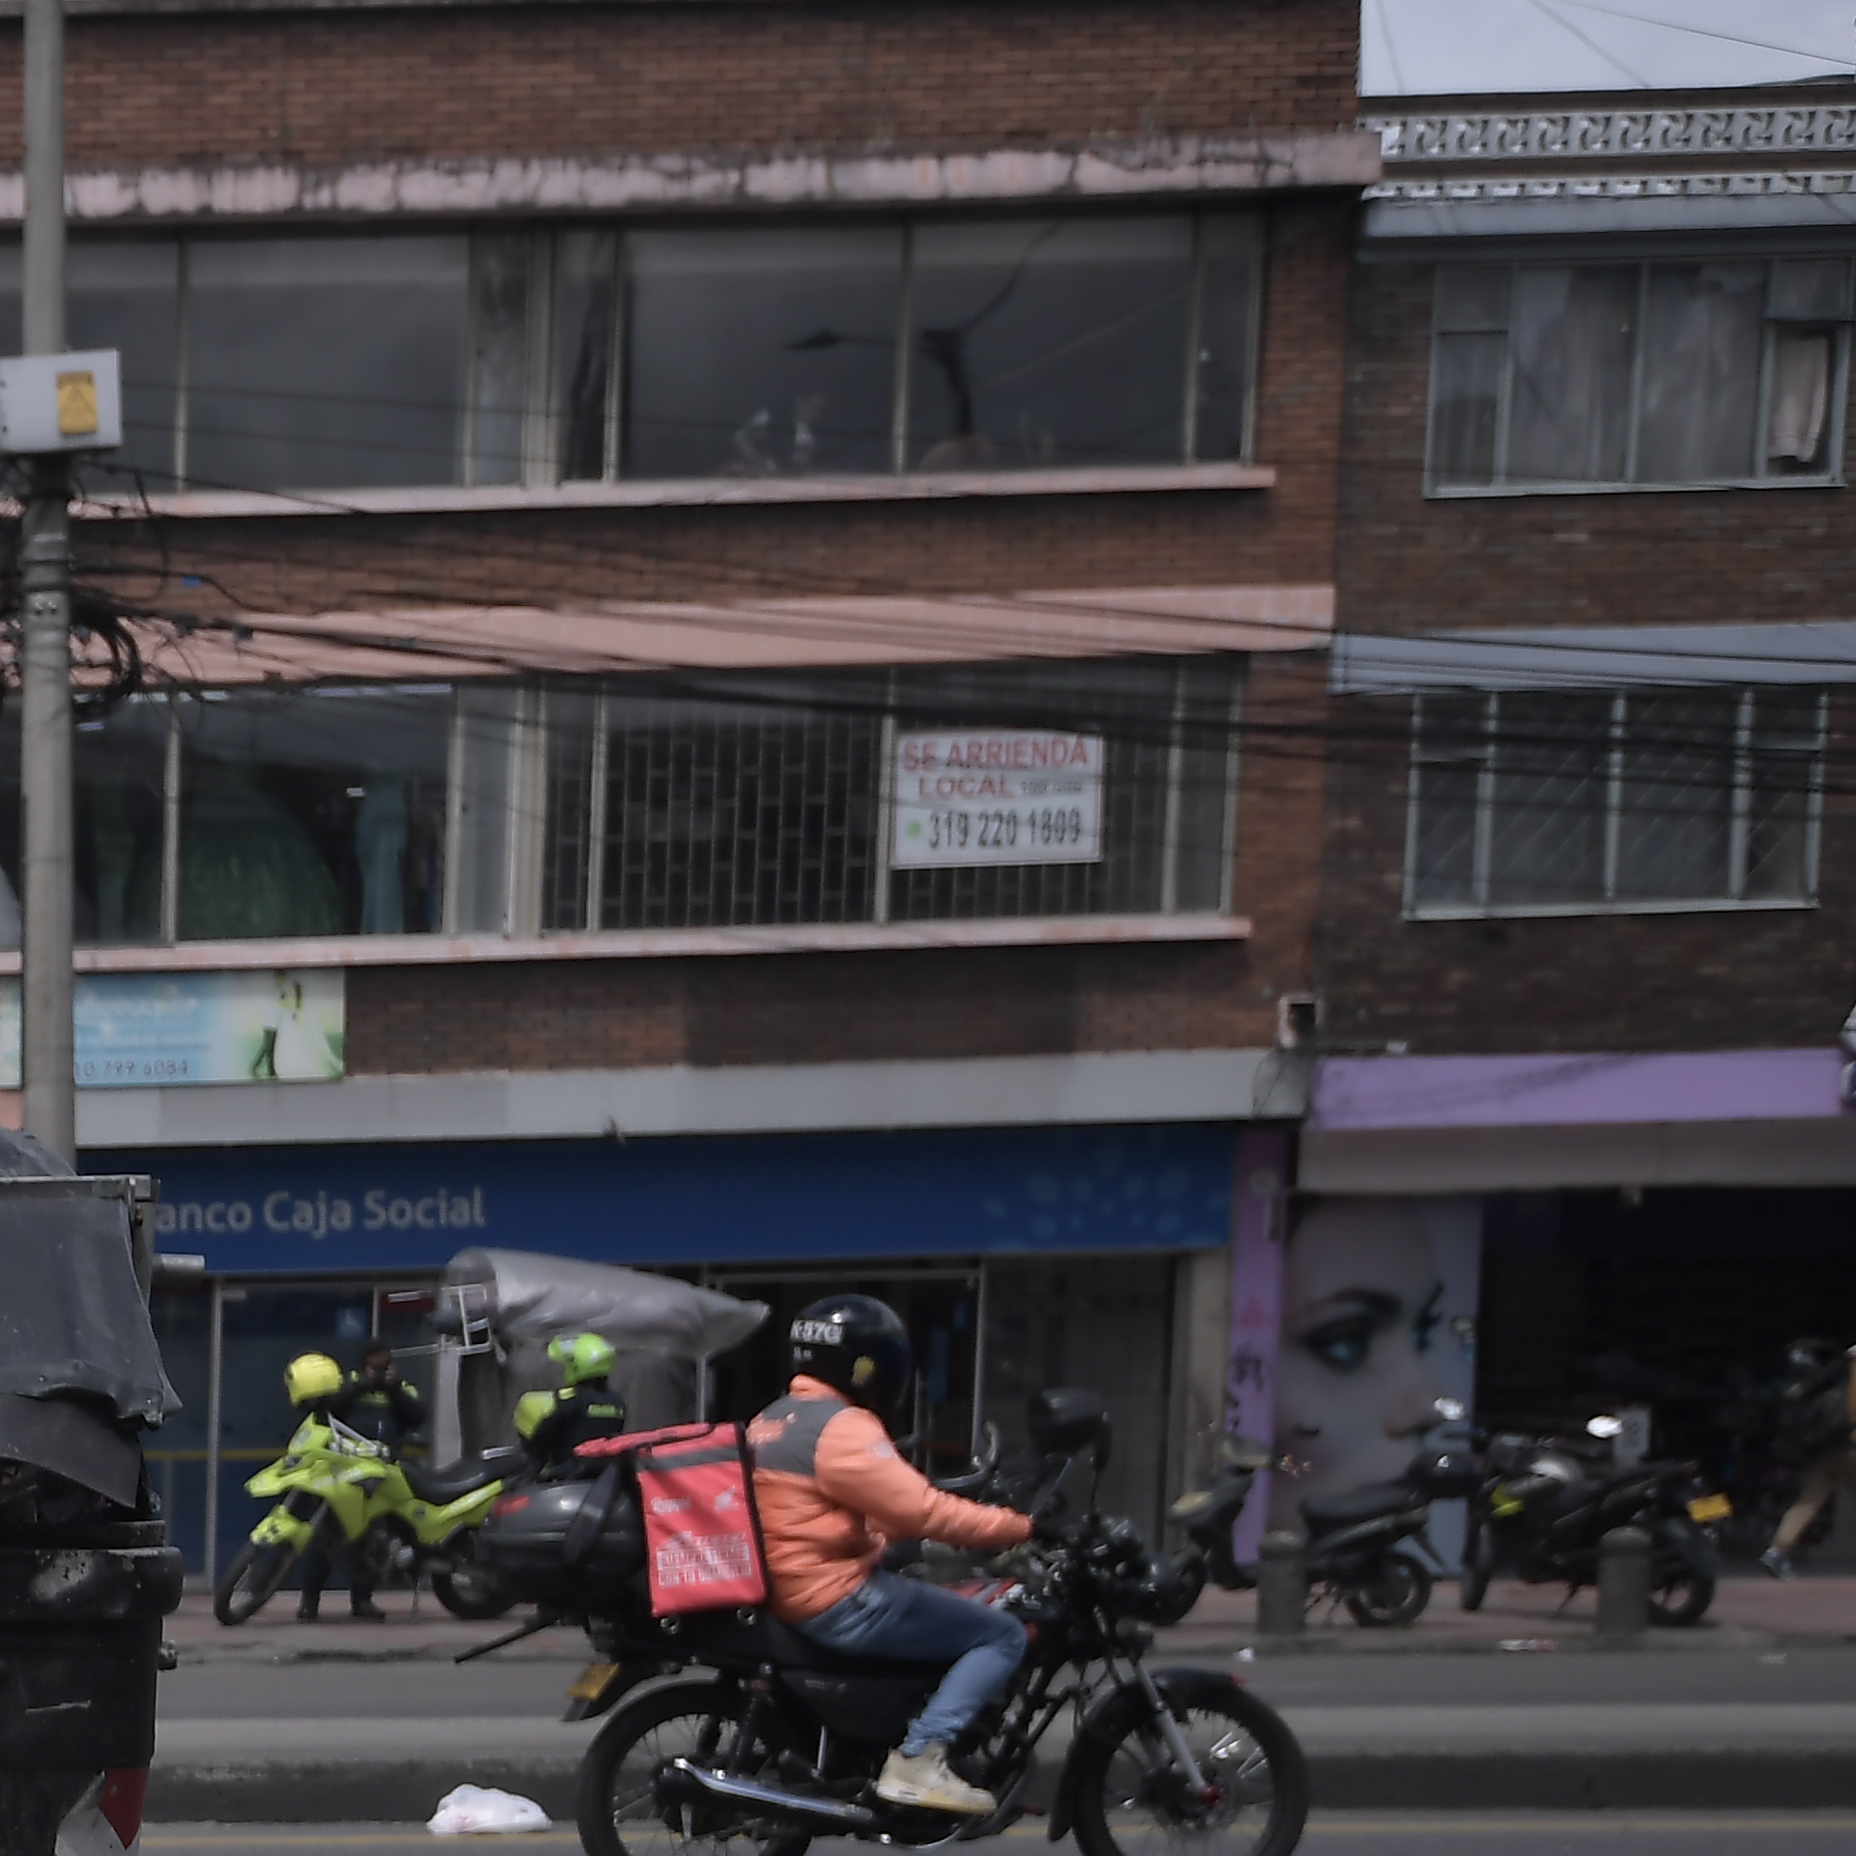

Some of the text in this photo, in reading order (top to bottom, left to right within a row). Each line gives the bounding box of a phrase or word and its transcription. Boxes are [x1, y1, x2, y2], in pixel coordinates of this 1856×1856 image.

[903, 735, 1089, 771] SE ARRIENDA
[917, 775, 1015, 799] LOCAL
[928, 810, 970, 849] 319
[977, 808, 1019, 847] 220
[156, 1185, 488, 1241] anco Caja Social
